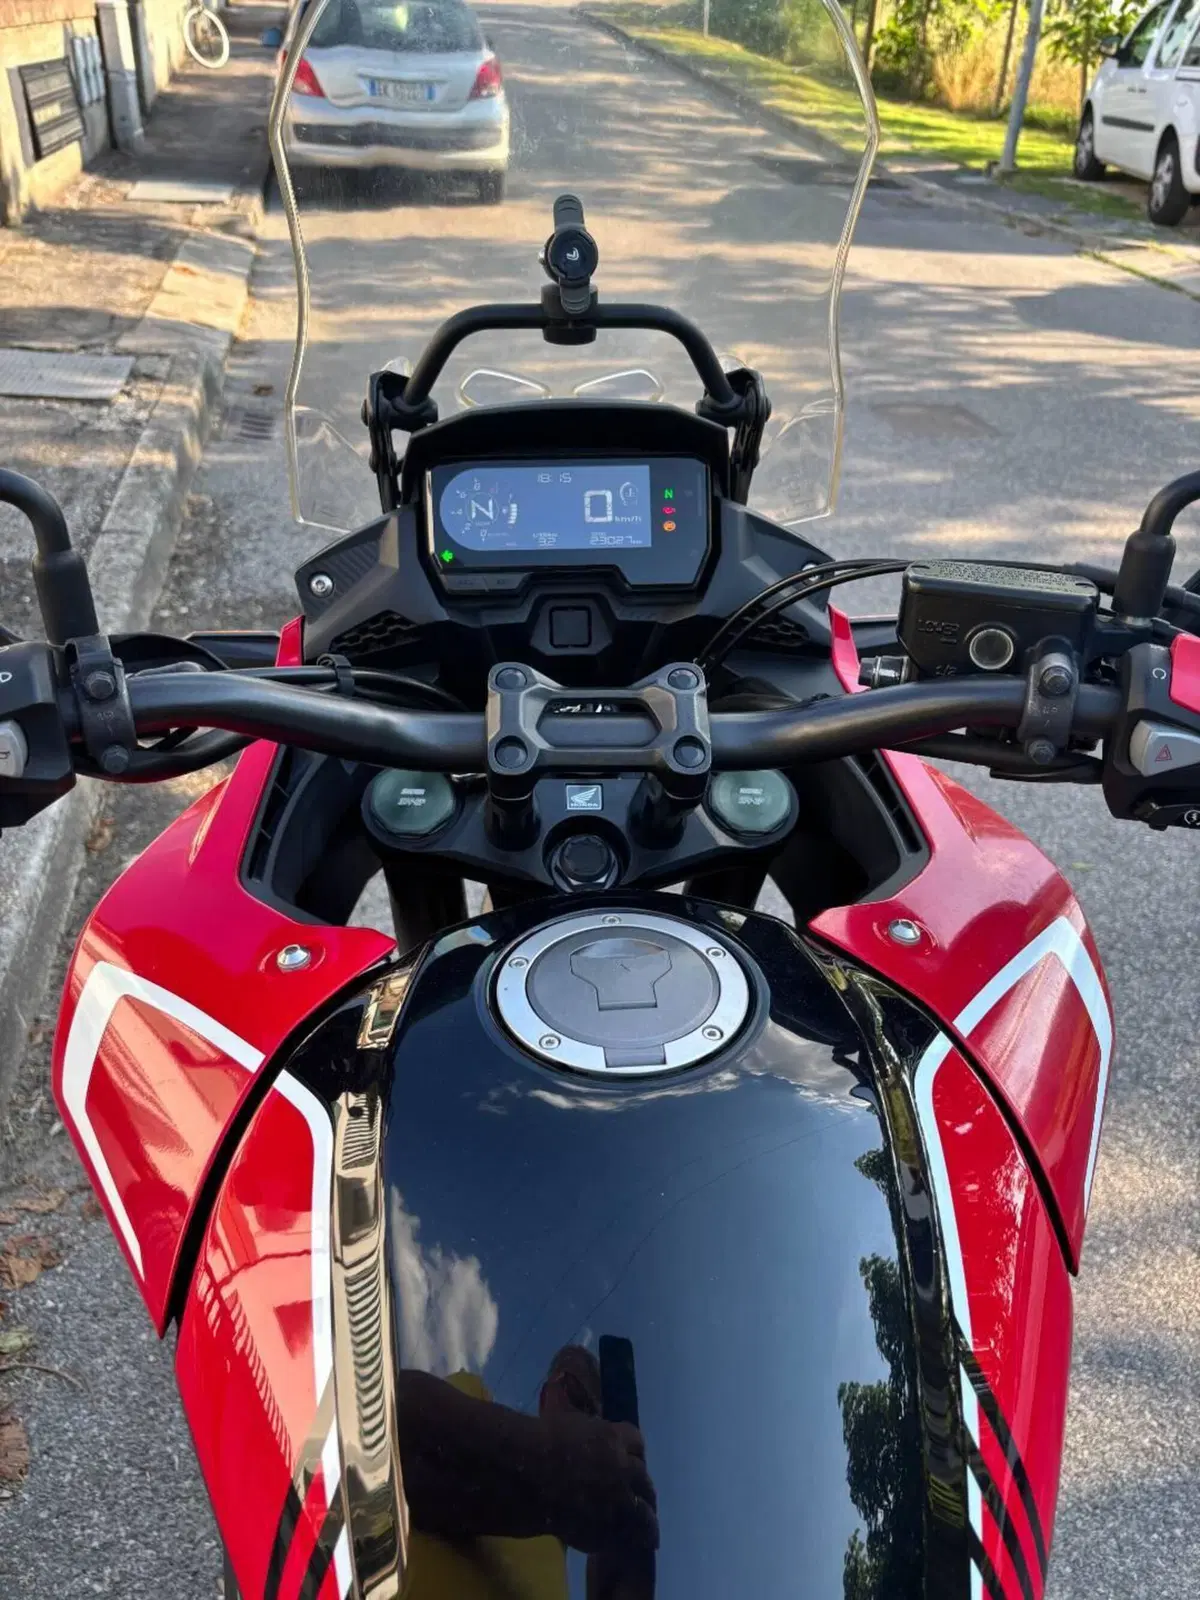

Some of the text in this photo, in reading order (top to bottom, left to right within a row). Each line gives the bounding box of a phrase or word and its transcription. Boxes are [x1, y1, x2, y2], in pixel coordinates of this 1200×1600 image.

[664, 488, 673, 499] N
[471, 499, 494, 520] N
[584, 490, 612, 522] 0
